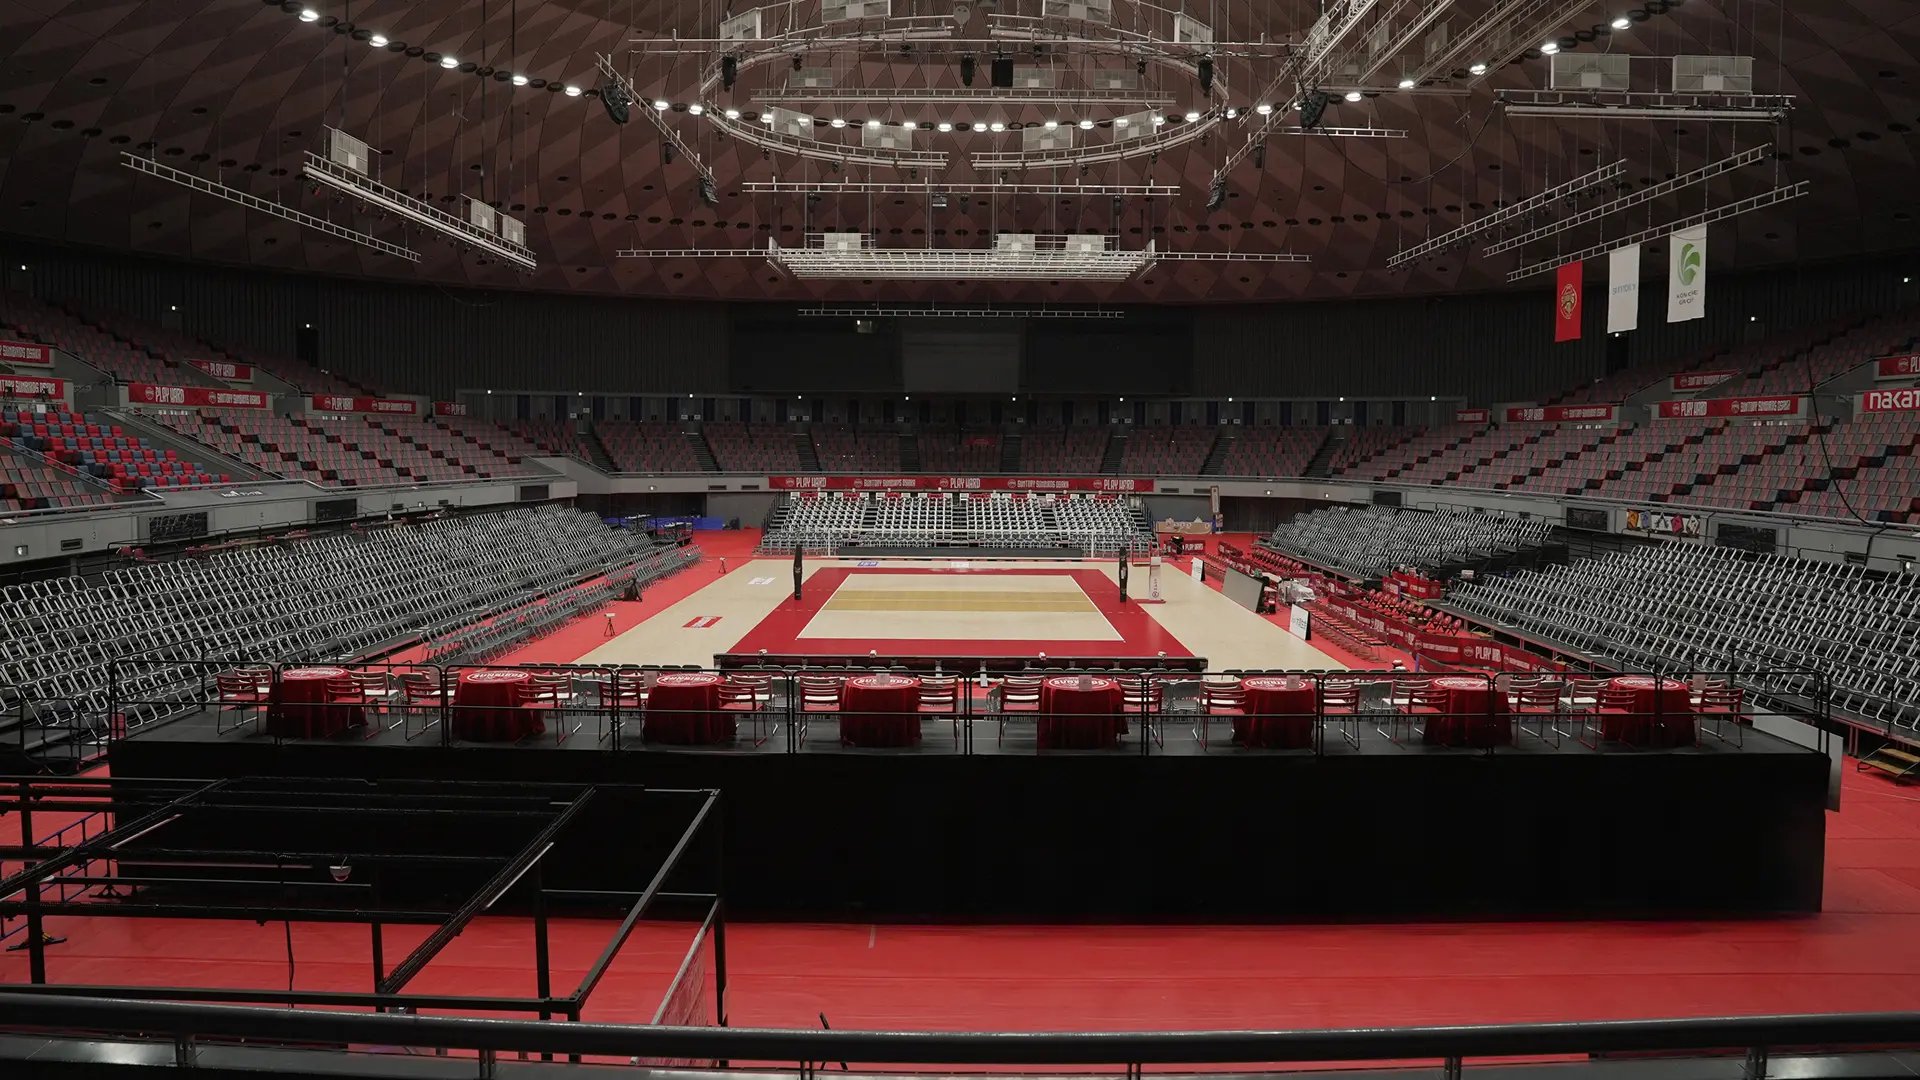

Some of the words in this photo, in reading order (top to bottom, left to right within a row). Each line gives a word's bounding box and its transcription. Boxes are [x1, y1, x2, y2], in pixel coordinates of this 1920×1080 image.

[155, 386, 170, 403] PLAY
[170, 388, 185, 404] HARD
[1680, 402, 1694, 416] PLAY
[1694, 401, 1707, 415] HARD
[796, 477, 810, 487] PLAY
[811, 477, 827, 487] HARD
[864, 479, 882, 487] SUNTORY
[950, 478, 964, 488] PLAY
[965, 478, 980, 488] HARD
[1017, 480, 1035, 488] SUNTORY
[1103, 479, 1118, 489] PLAY
[1119, 479, 1134, 489] HARD
[1475, 646, 1492, 660] PLAY
